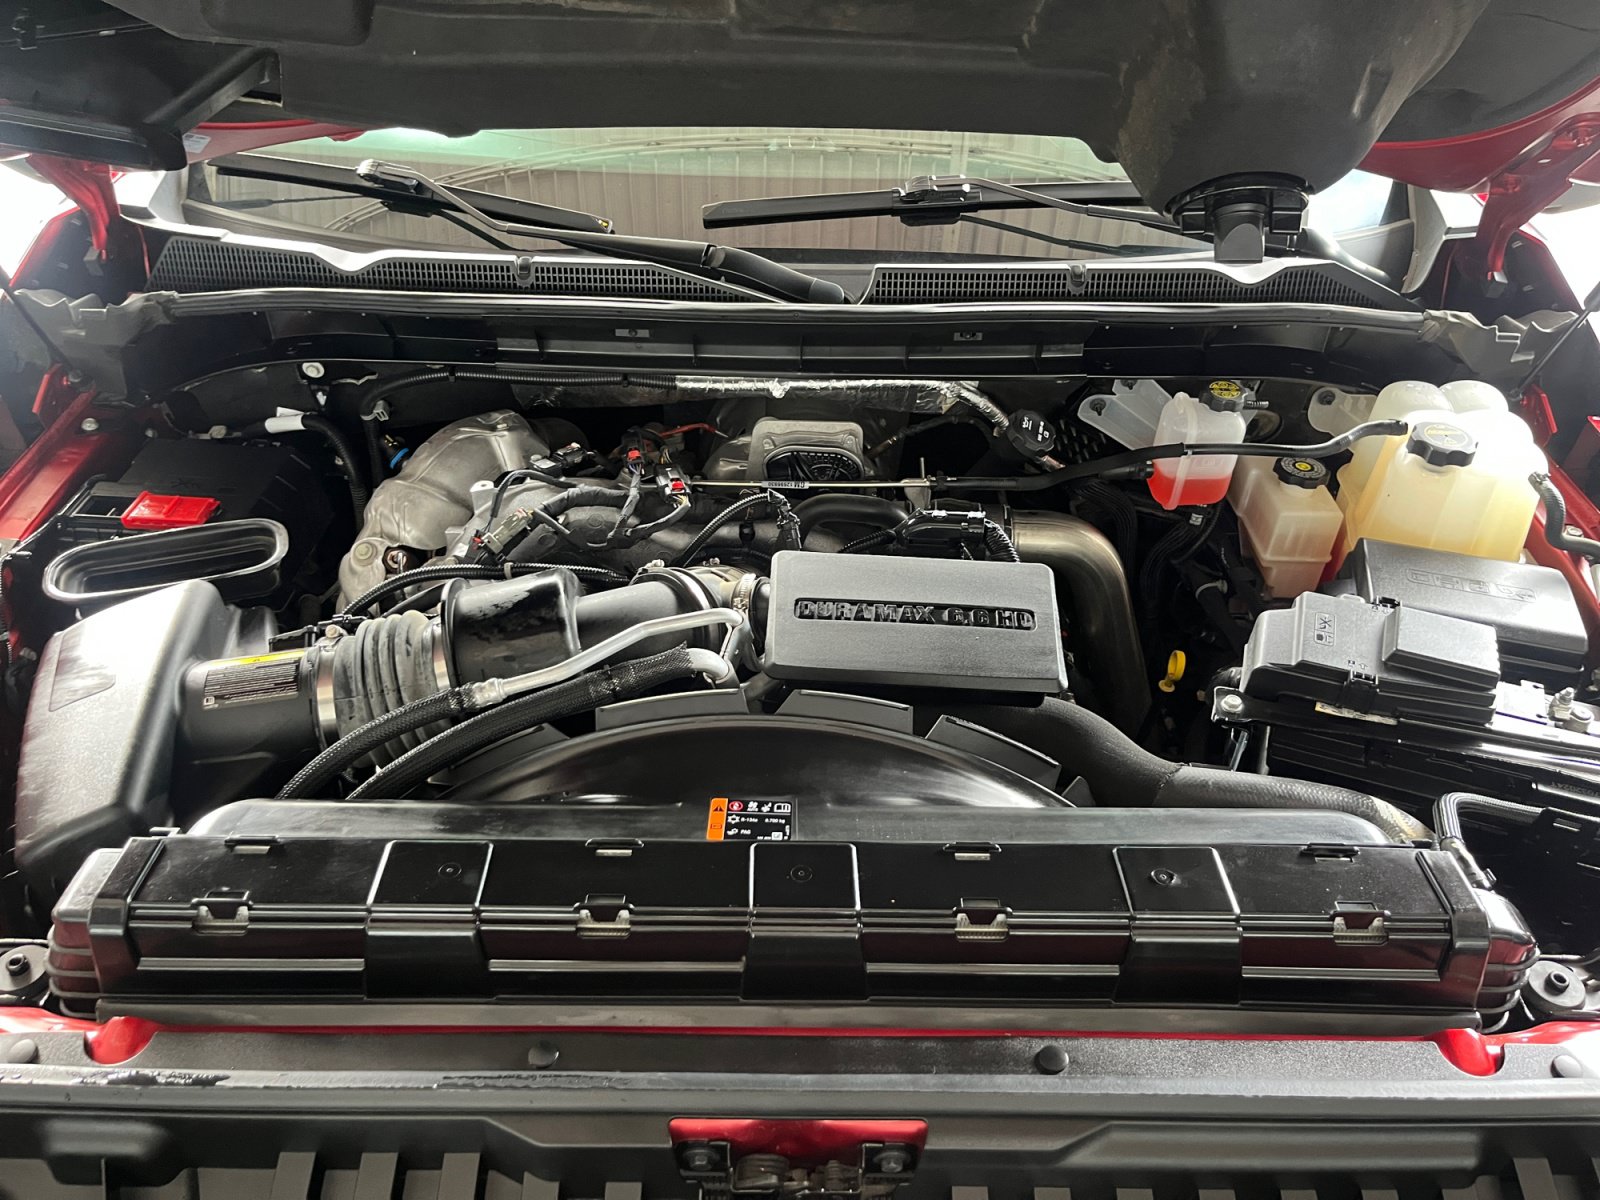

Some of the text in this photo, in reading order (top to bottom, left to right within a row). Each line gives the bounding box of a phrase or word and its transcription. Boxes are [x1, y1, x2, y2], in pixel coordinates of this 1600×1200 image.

[797, 600, 1035, 629] DURAMAX 6.6 HD
